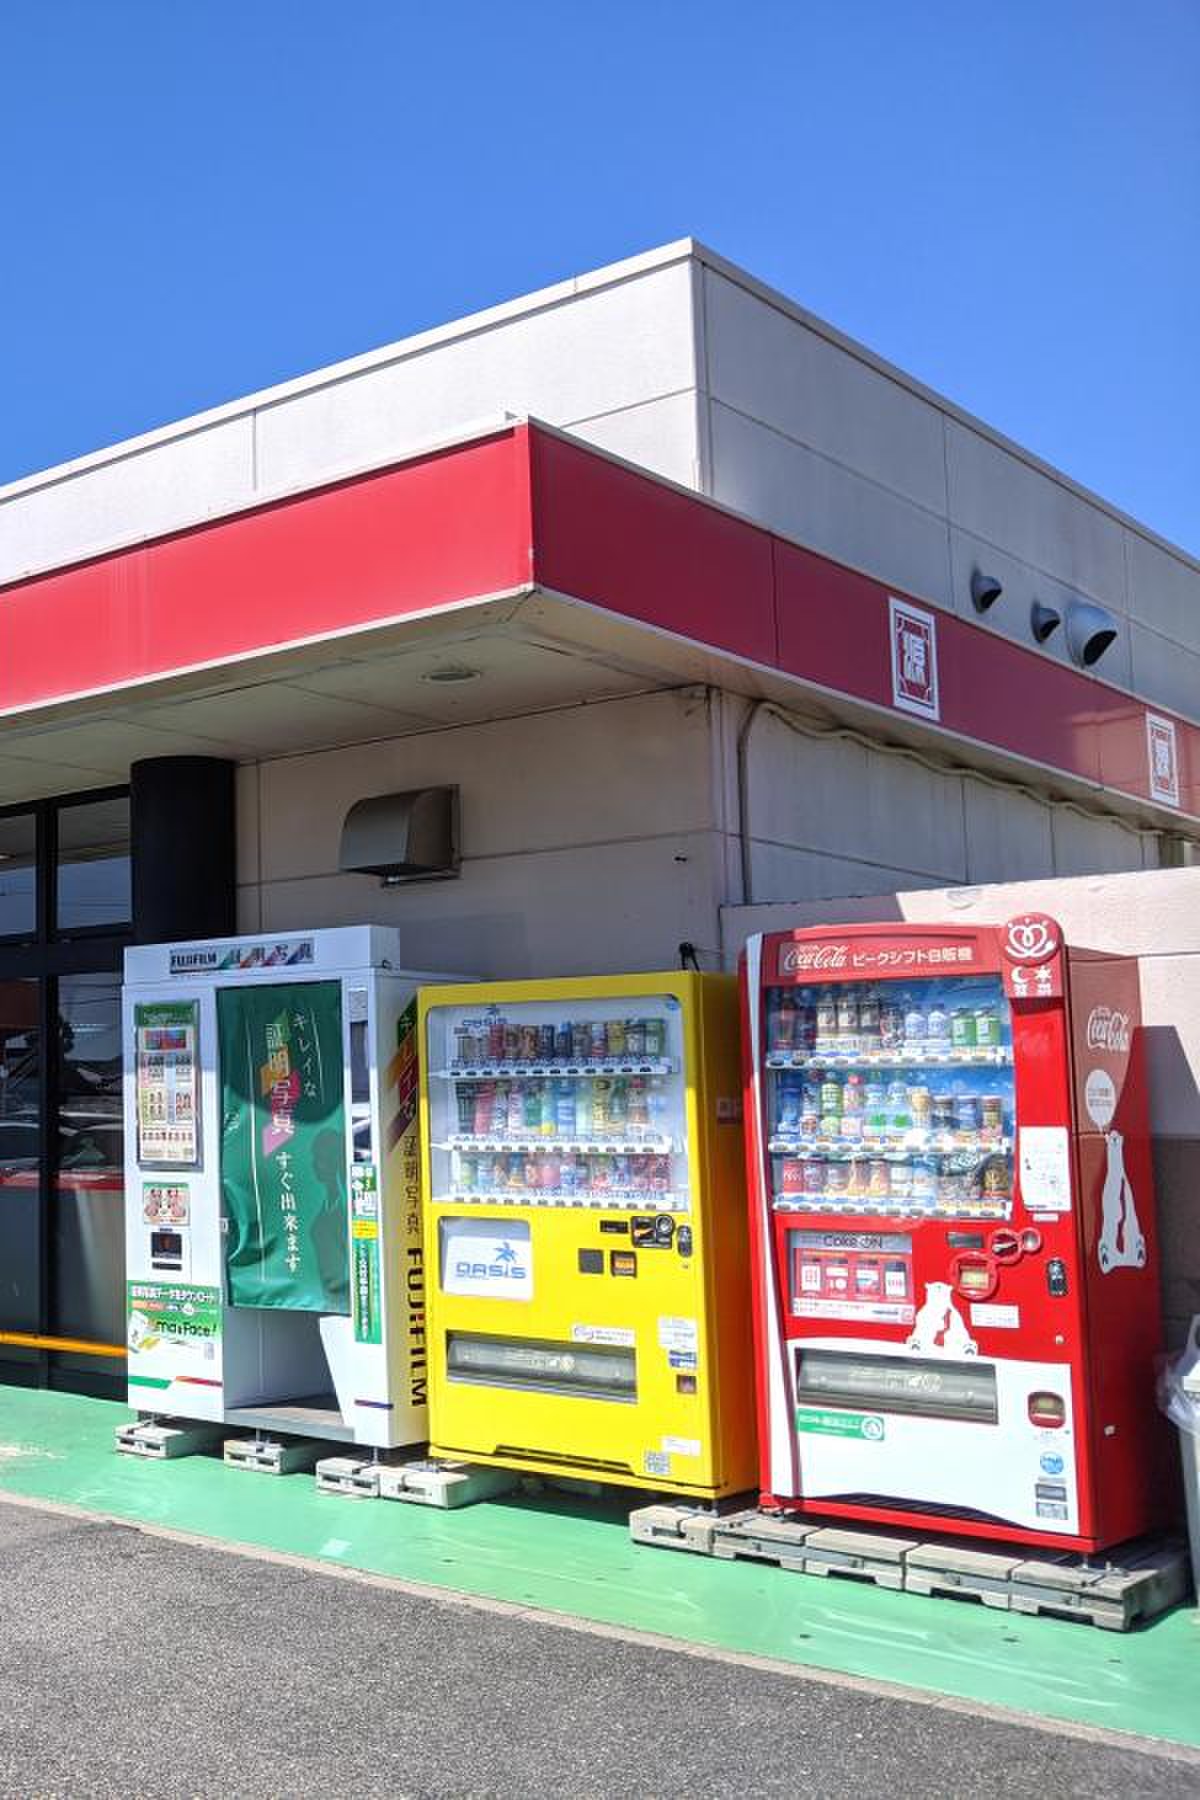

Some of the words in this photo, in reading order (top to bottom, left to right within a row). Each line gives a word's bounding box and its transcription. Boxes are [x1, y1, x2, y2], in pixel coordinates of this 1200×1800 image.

[171, 952, 217, 968] FUJIFILM
[784, 944, 849, 972] Coca-Cola
[853, 946, 973, 968] ピークシフト自販機
[265, 1023, 296, 1136] 証明写真
[293, 1012, 317, 1098] キレイな
[275, 1151, 301, 1273] すぐ出来ます
[407, 1247, 428, 1408] FUJIFILM
